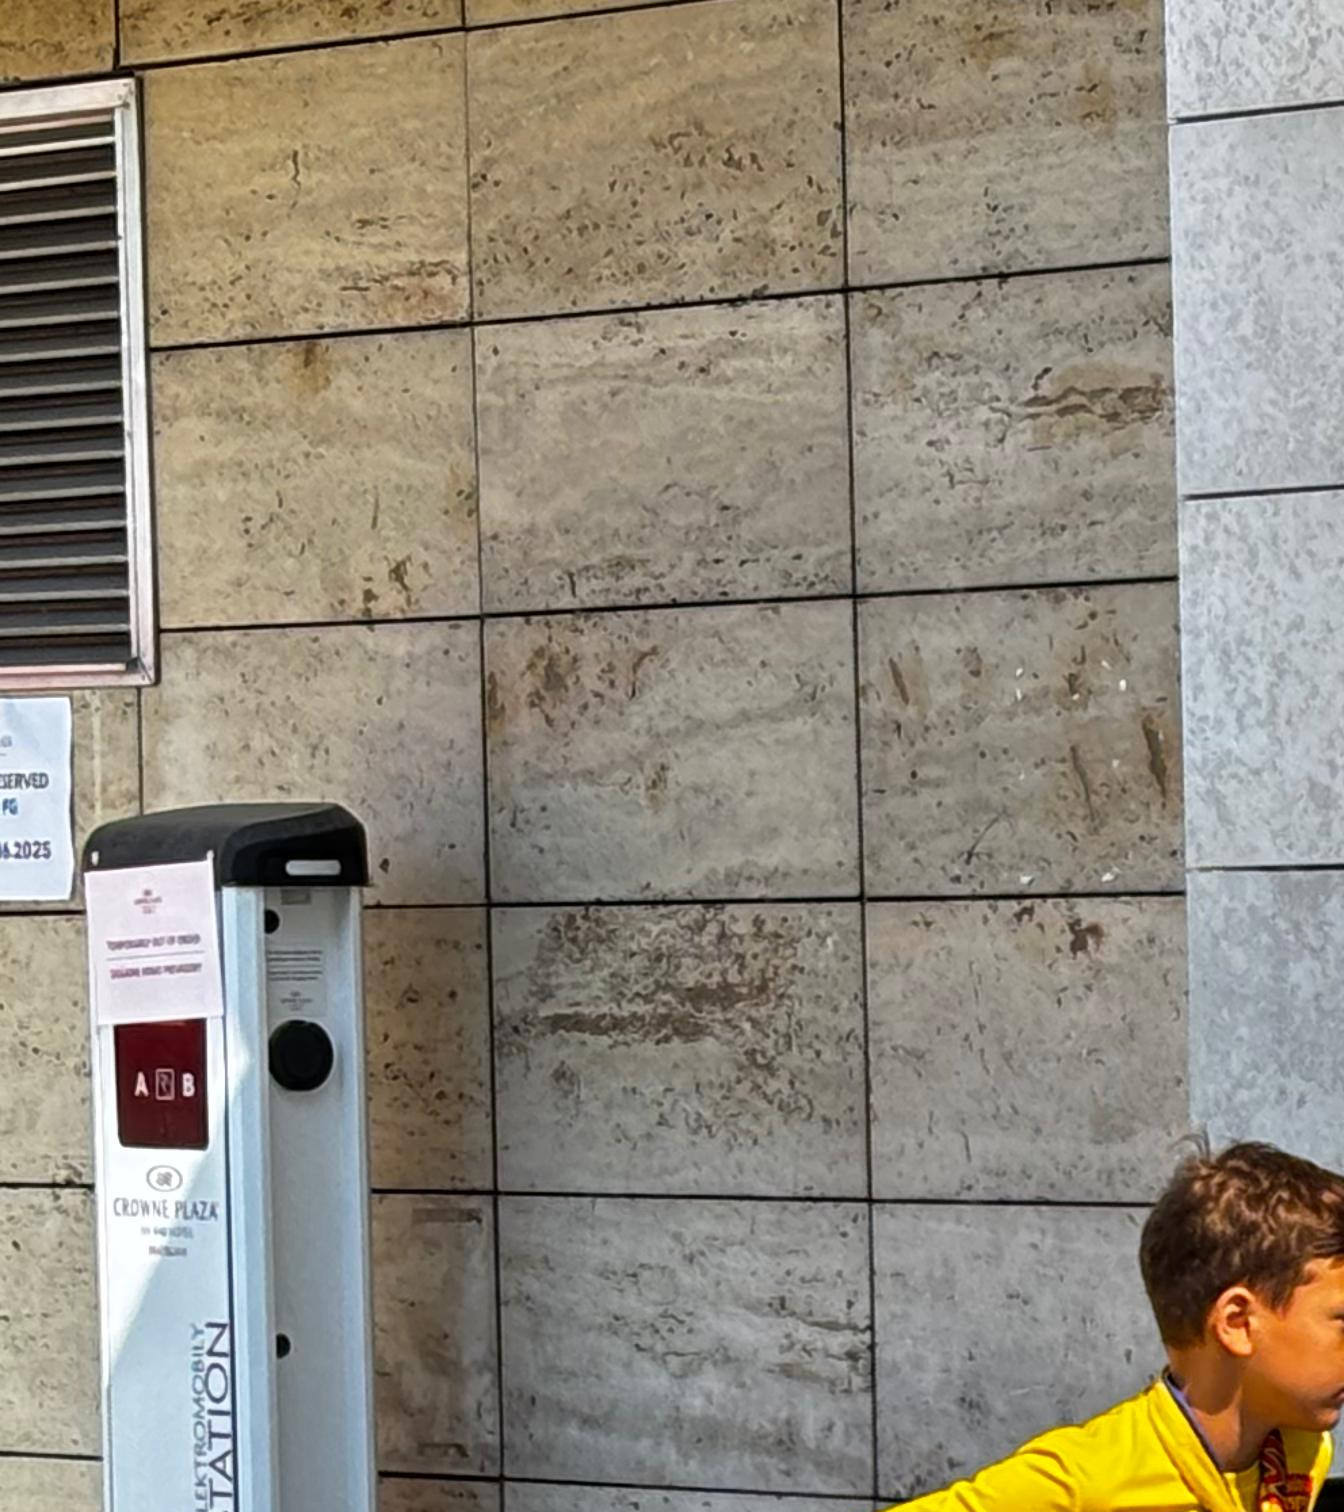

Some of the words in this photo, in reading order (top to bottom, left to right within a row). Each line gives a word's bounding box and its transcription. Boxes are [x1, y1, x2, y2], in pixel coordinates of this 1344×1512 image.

[134, 1072, 149, 1097] A
[182, 1073, 195, 1097] B
[113, 1197, 170, 1220] CROWNE
[174, 1200, 218, 1221] PLAZA
